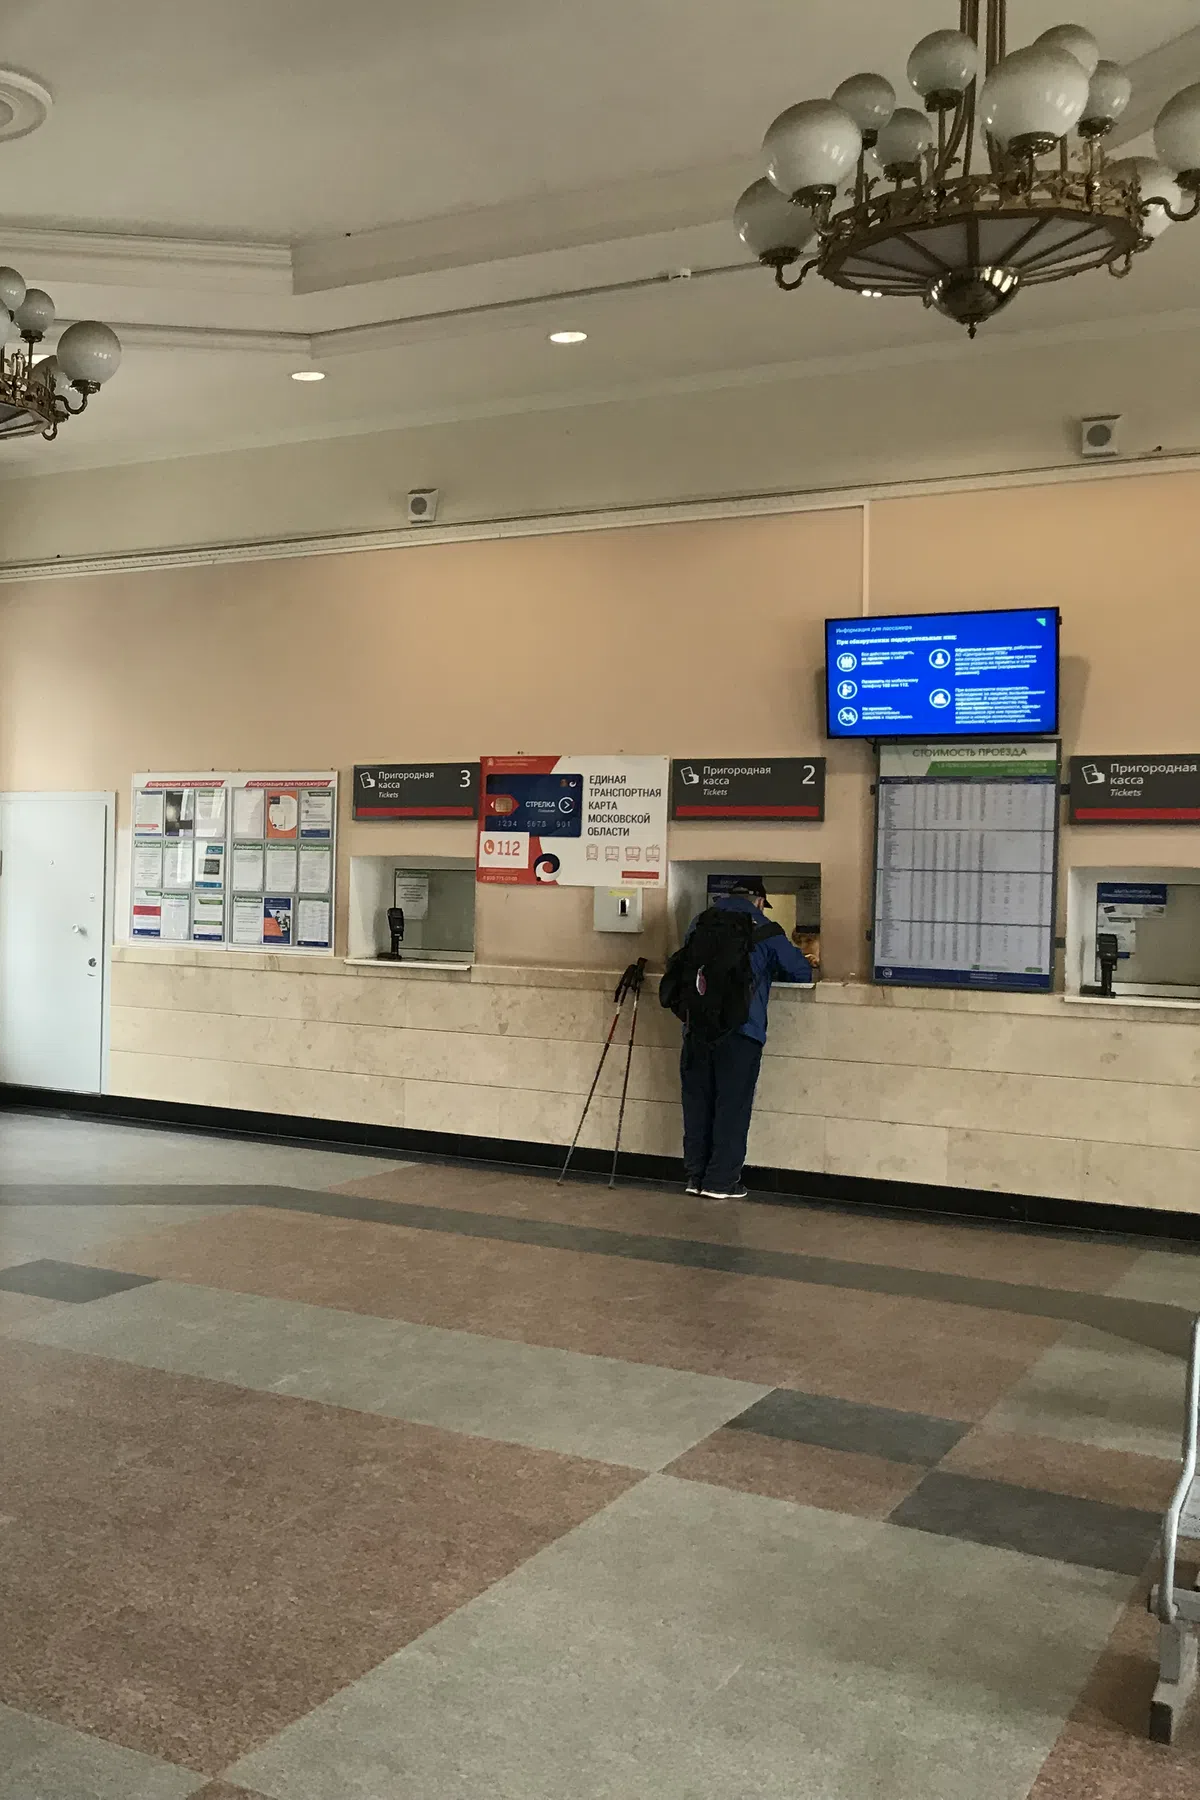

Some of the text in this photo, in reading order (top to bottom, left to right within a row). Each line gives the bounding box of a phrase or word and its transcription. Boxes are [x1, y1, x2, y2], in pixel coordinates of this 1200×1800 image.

[912, 747, 1028, 758] СТОИМОСТЬ ПРОЕЗДА
[1110, 763, 1198, 775] Пригородная
[378, 769, 471, 788] Пригородная 3
[703, 764, 816, 785] Пригородная 2
[378, 781, 401, 789] касса
[589, 775, 627, 785] ЕДИНАЯ
[702, 777, 730, 785] касса
[1110, 776, 1144, 785] касса
[378, 791, 399, 799] Tickets
[589, 788, 662, 798] ТРАНСПОРТНАЯ
[703, 788, 728, 796] Tickets
[1110, 788, 1142, 797] Tickets
[588, 801, 618, 810] КАРТА
[587, 812, 651, 824] МОСКОВСКОЙ
[587, 827, 630, 837] ОБЛАСТИ
[497, 840, 521, 856] 112
